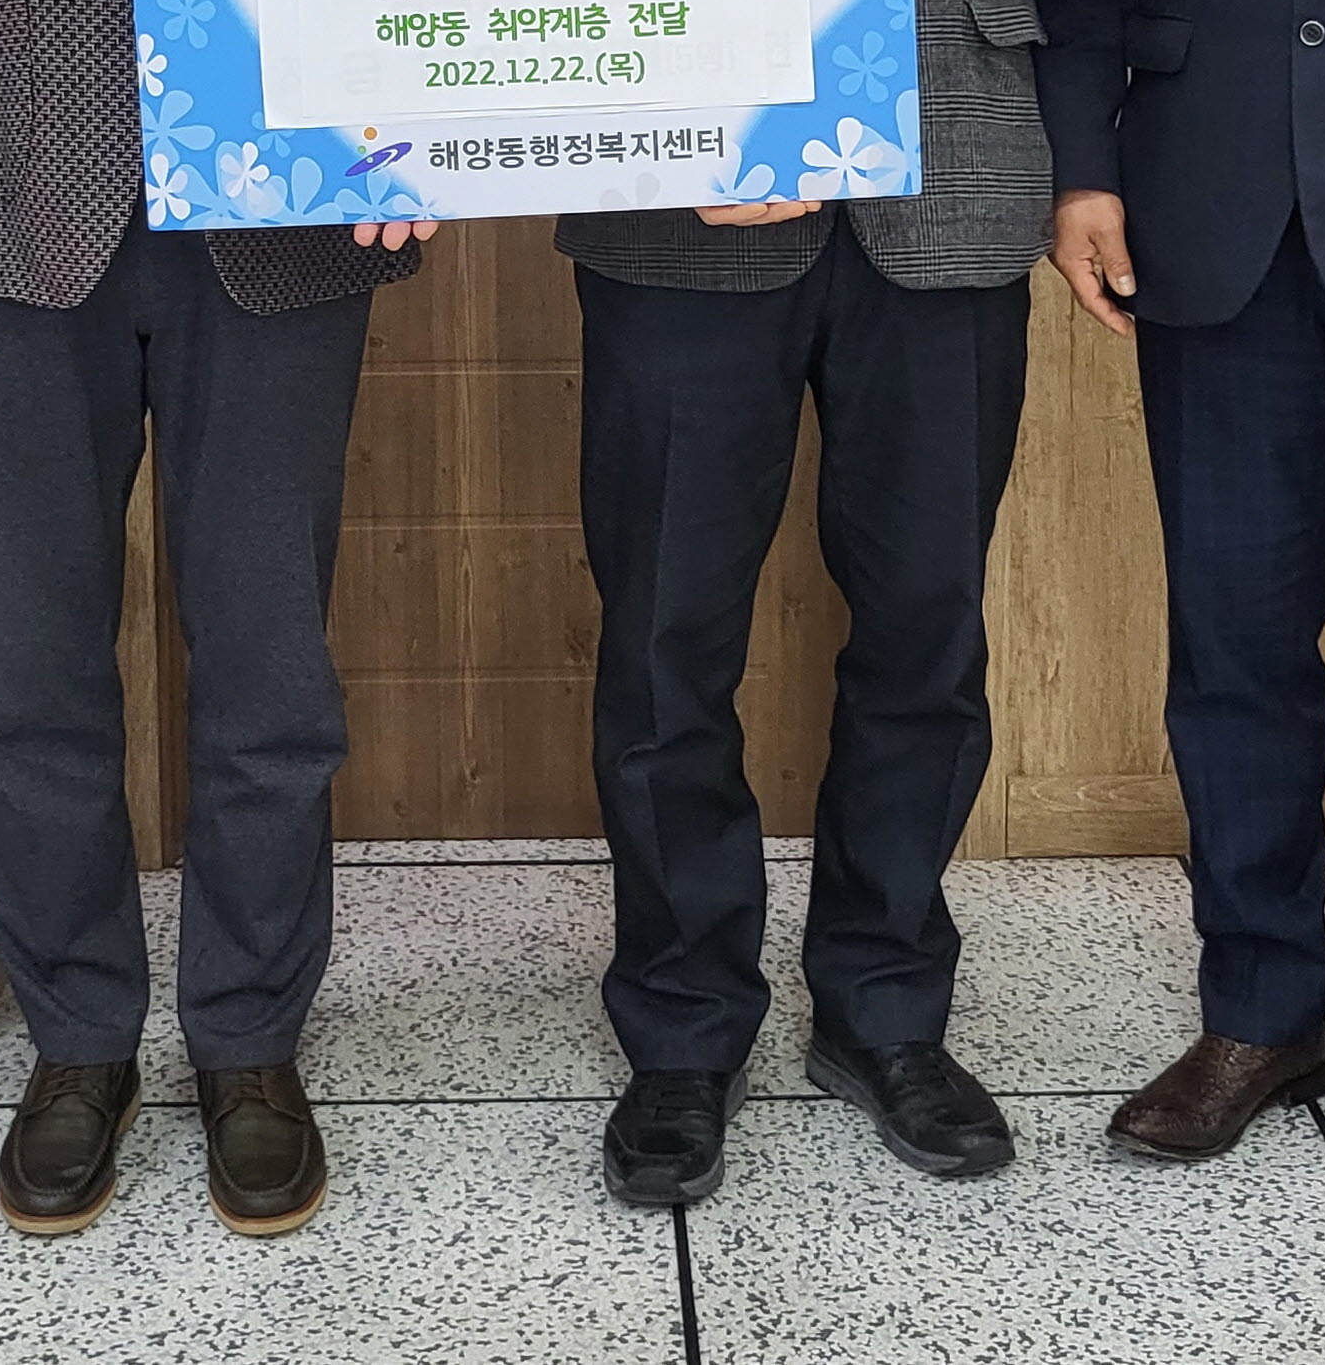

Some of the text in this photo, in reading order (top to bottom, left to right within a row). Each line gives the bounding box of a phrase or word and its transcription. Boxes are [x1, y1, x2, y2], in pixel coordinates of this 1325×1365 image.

[375, 1, 690, 48] 해양동 취약계층 전달
[425, 51, 645, 87] 2022.12.22.(목)
[428, 126, 725, 171] 해양동행정복지센터
